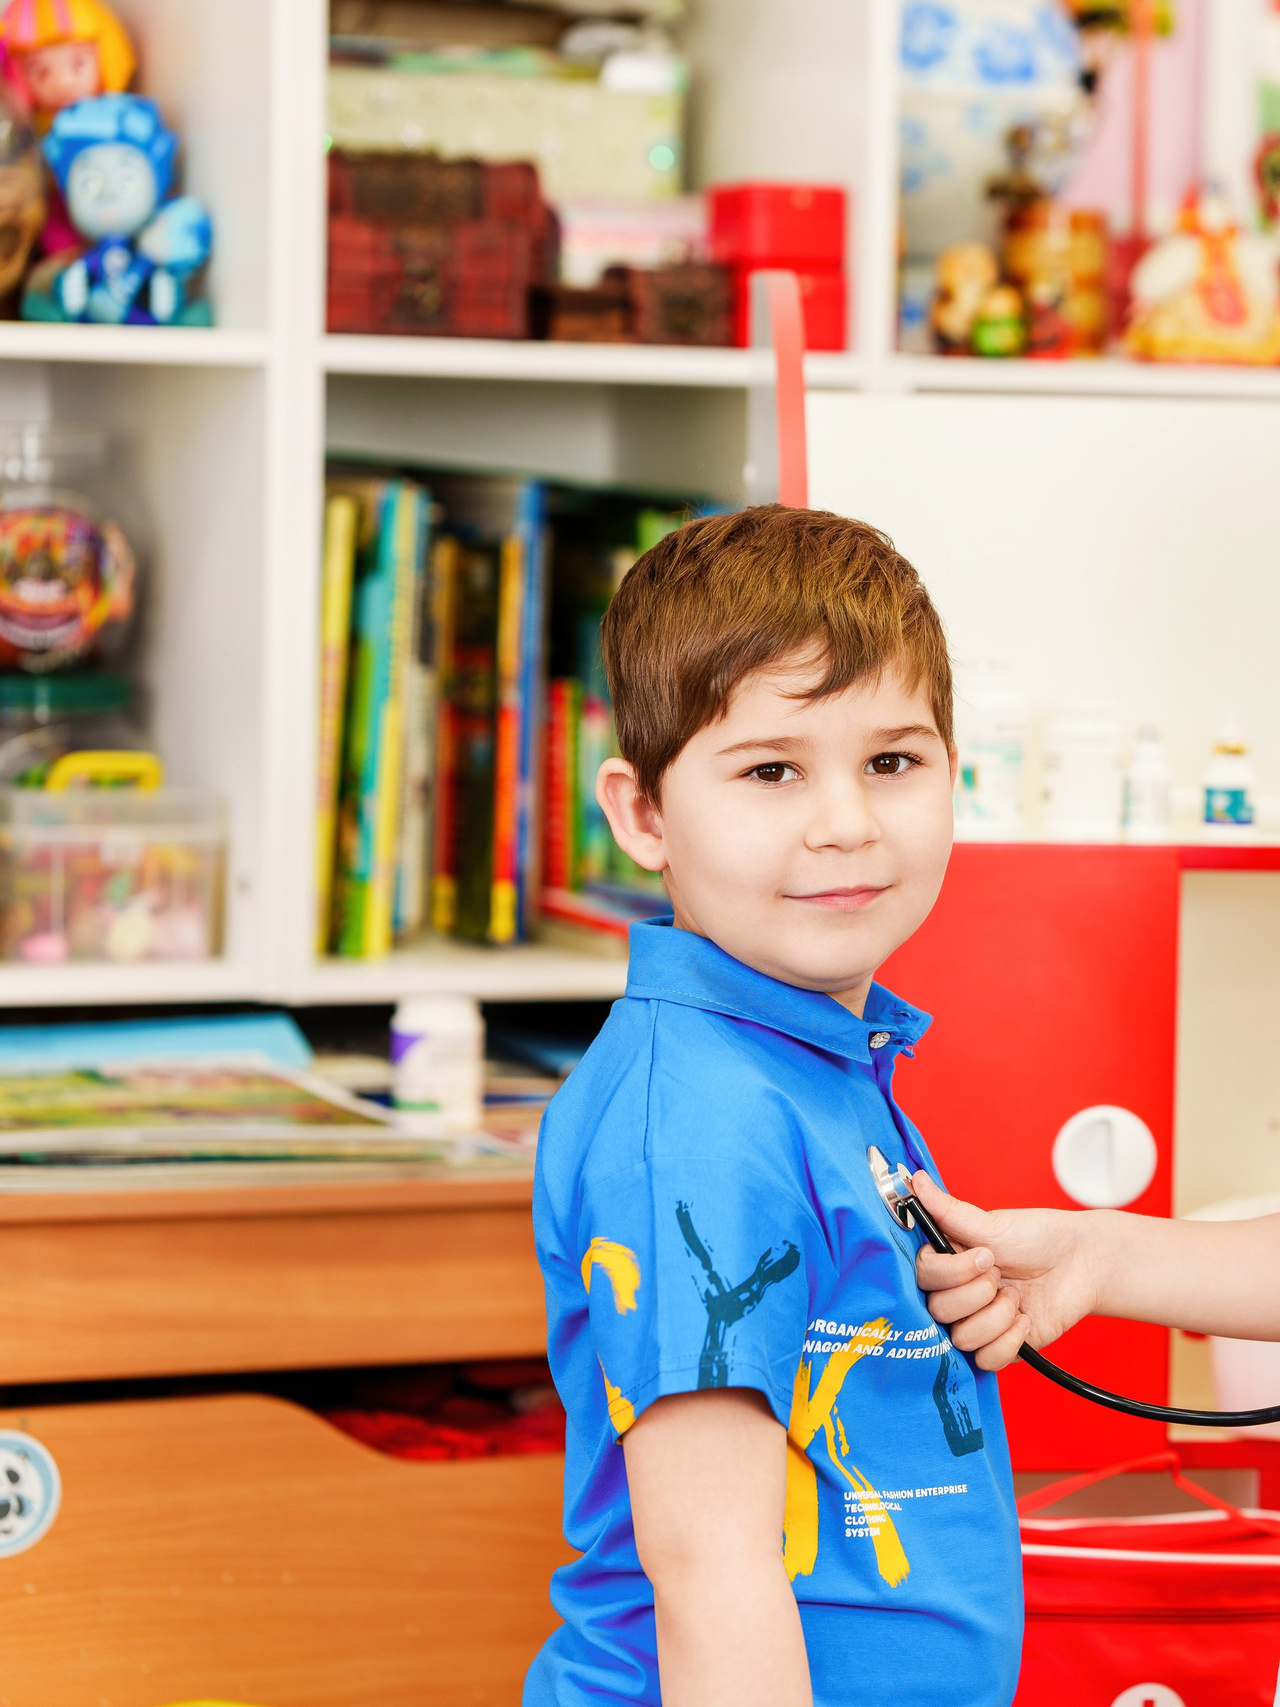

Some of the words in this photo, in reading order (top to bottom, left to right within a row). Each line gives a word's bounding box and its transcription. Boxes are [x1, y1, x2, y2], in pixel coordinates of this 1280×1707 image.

[853, 1343, 884, 1356] AND
[844, 1490, 883, 1501] UNIVERSAL
[883, 1489, 914, 1500] FASHION
[916, 1484, 968, 1498] ENTERPRISE
[844, 1502, 902, 1513] TECHNOLOGICAL
[844, 1513, 887, 1525] CLOTHING
[845, 1527, 880, 1538] SYSTEM
